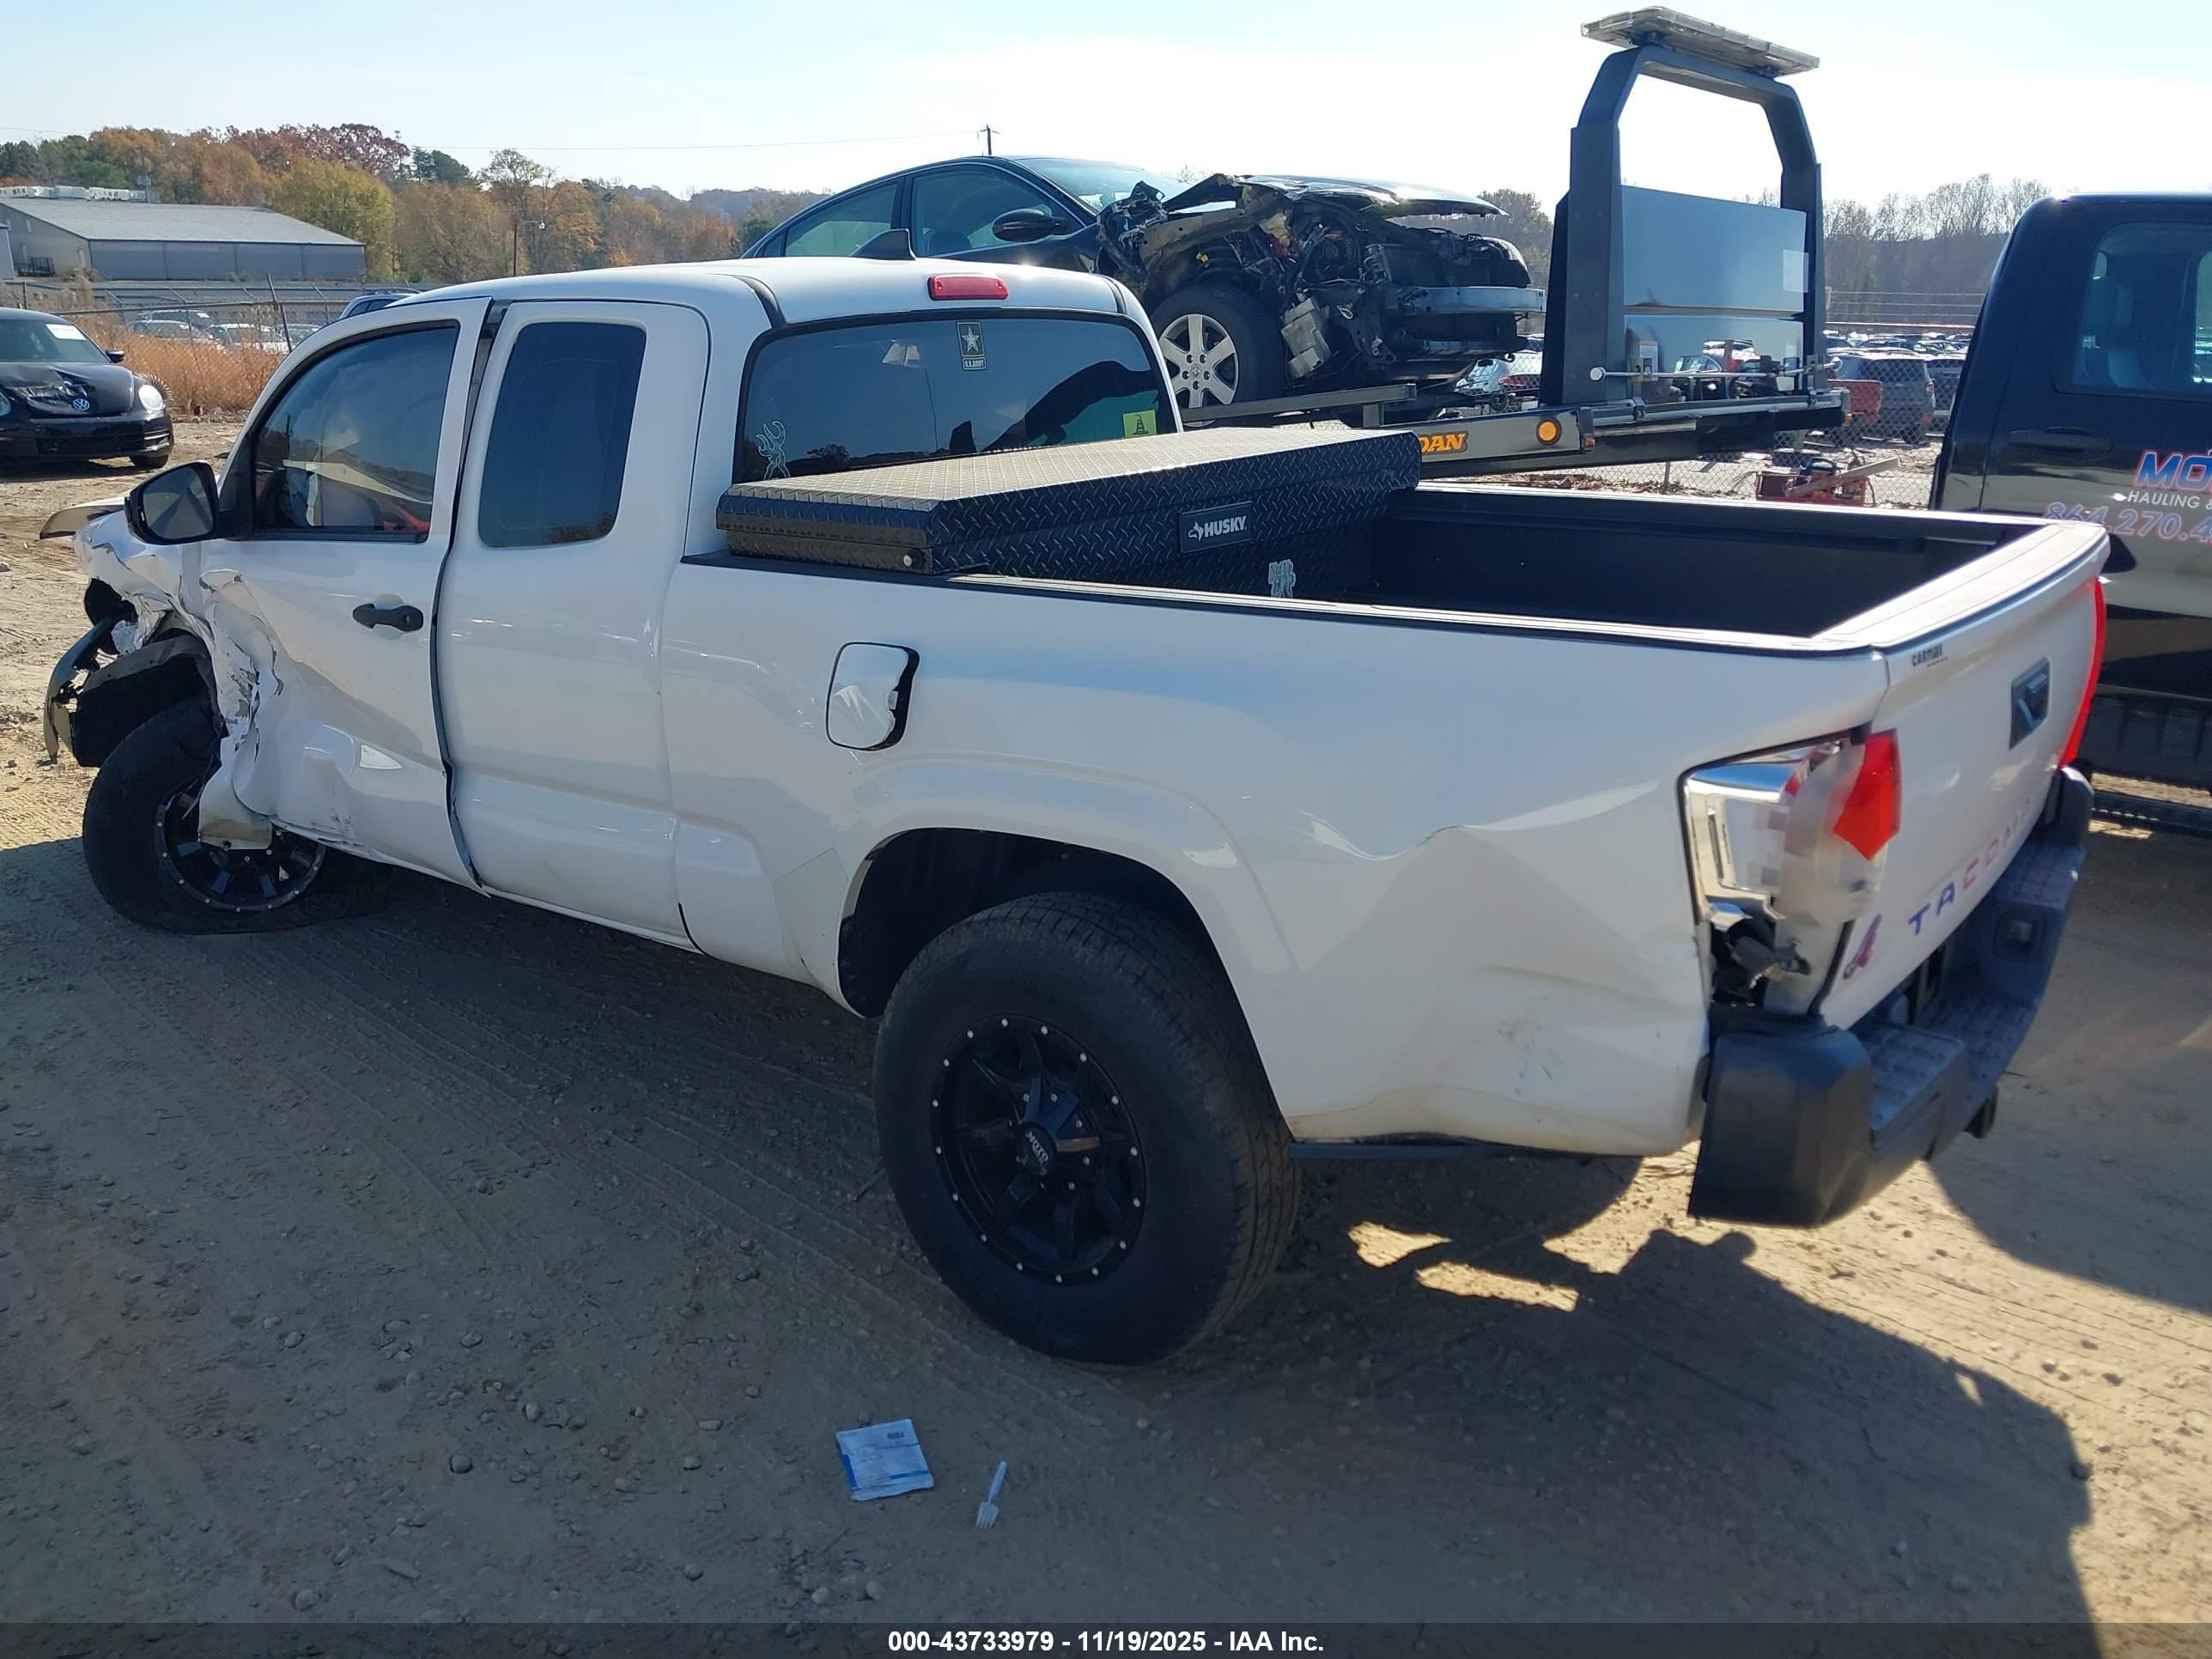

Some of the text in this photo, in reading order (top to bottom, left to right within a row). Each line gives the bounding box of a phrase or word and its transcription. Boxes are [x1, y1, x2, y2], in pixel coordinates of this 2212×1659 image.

[2127, 490, 2201, 509] HAULING
[1204, 515, 1247, 538] HUSKY
[1907, 794, 2033, 936] TACOMA
